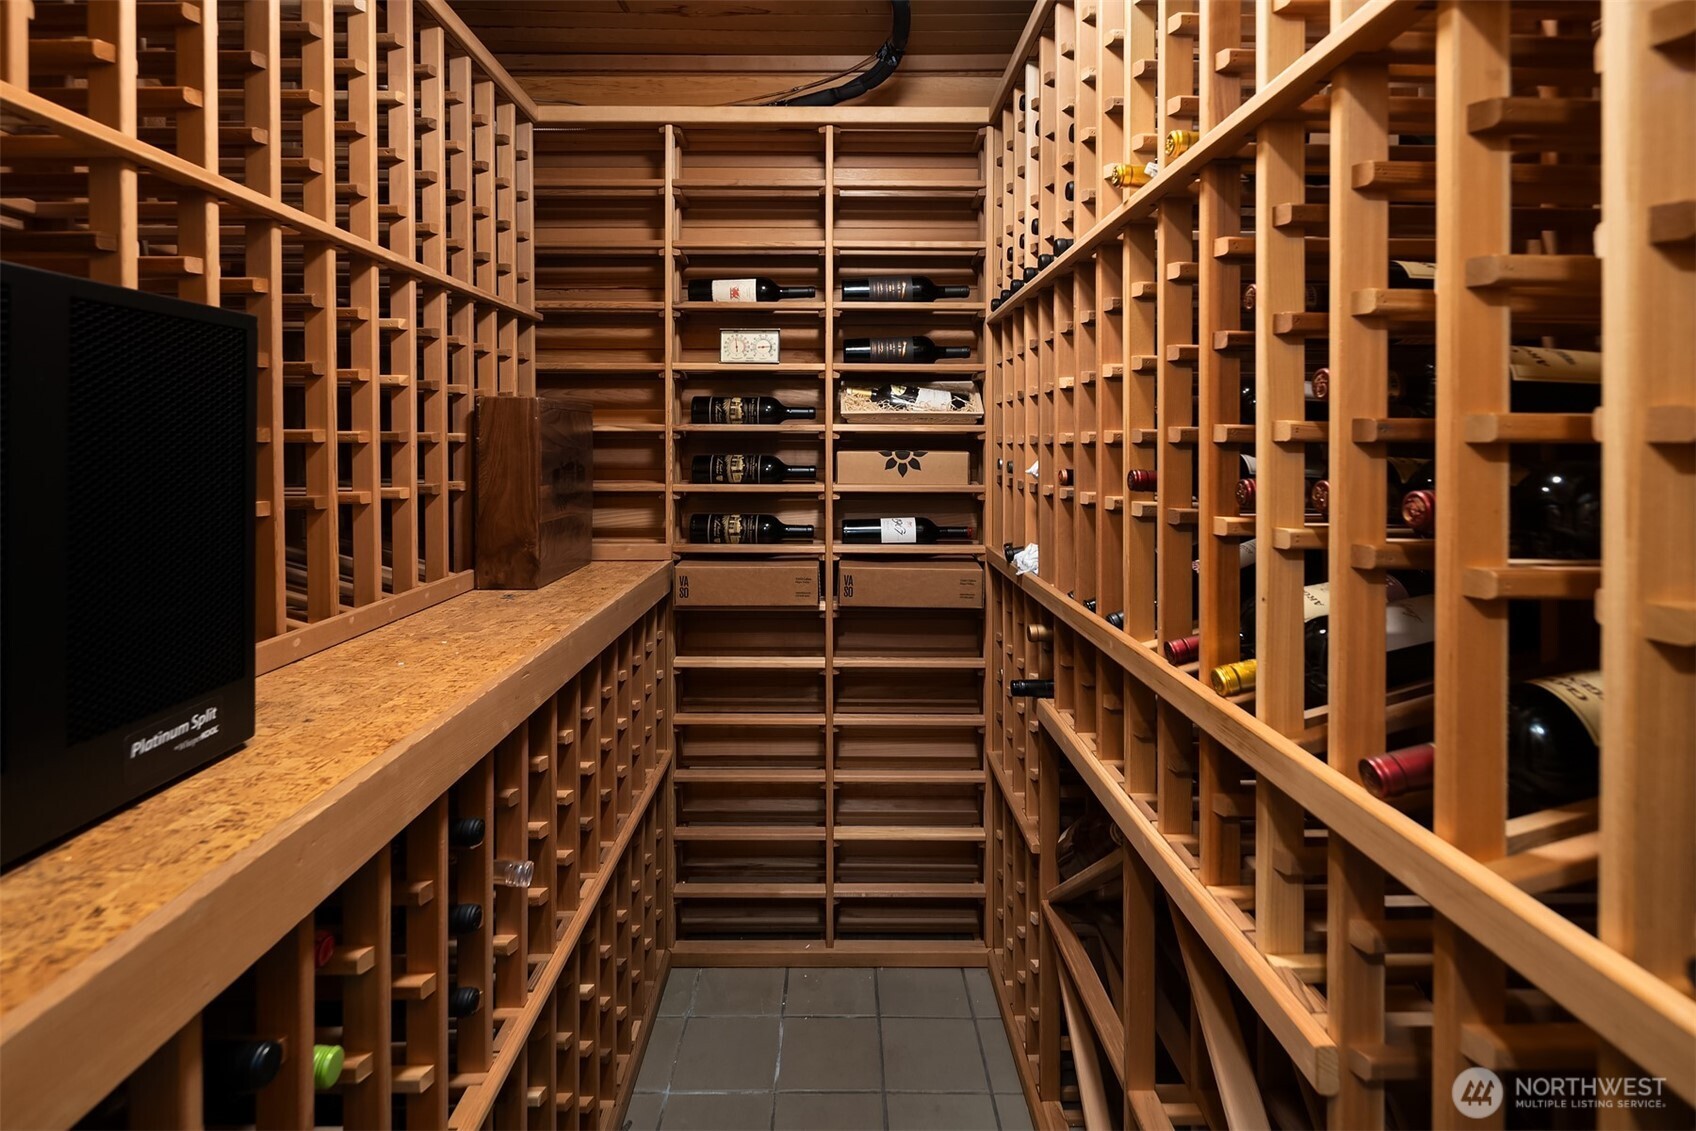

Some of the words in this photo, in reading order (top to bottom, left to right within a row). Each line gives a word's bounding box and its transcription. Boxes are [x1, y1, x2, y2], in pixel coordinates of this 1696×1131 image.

[679, 576, 689, 587] VA
[844, 575, 853, 586] VA
[679, 588, 689, 598] SO
[844, 587, 853, 598] SO
[130, 721, 190, 759] Platinum
[190, 707, 218, 730] Split
